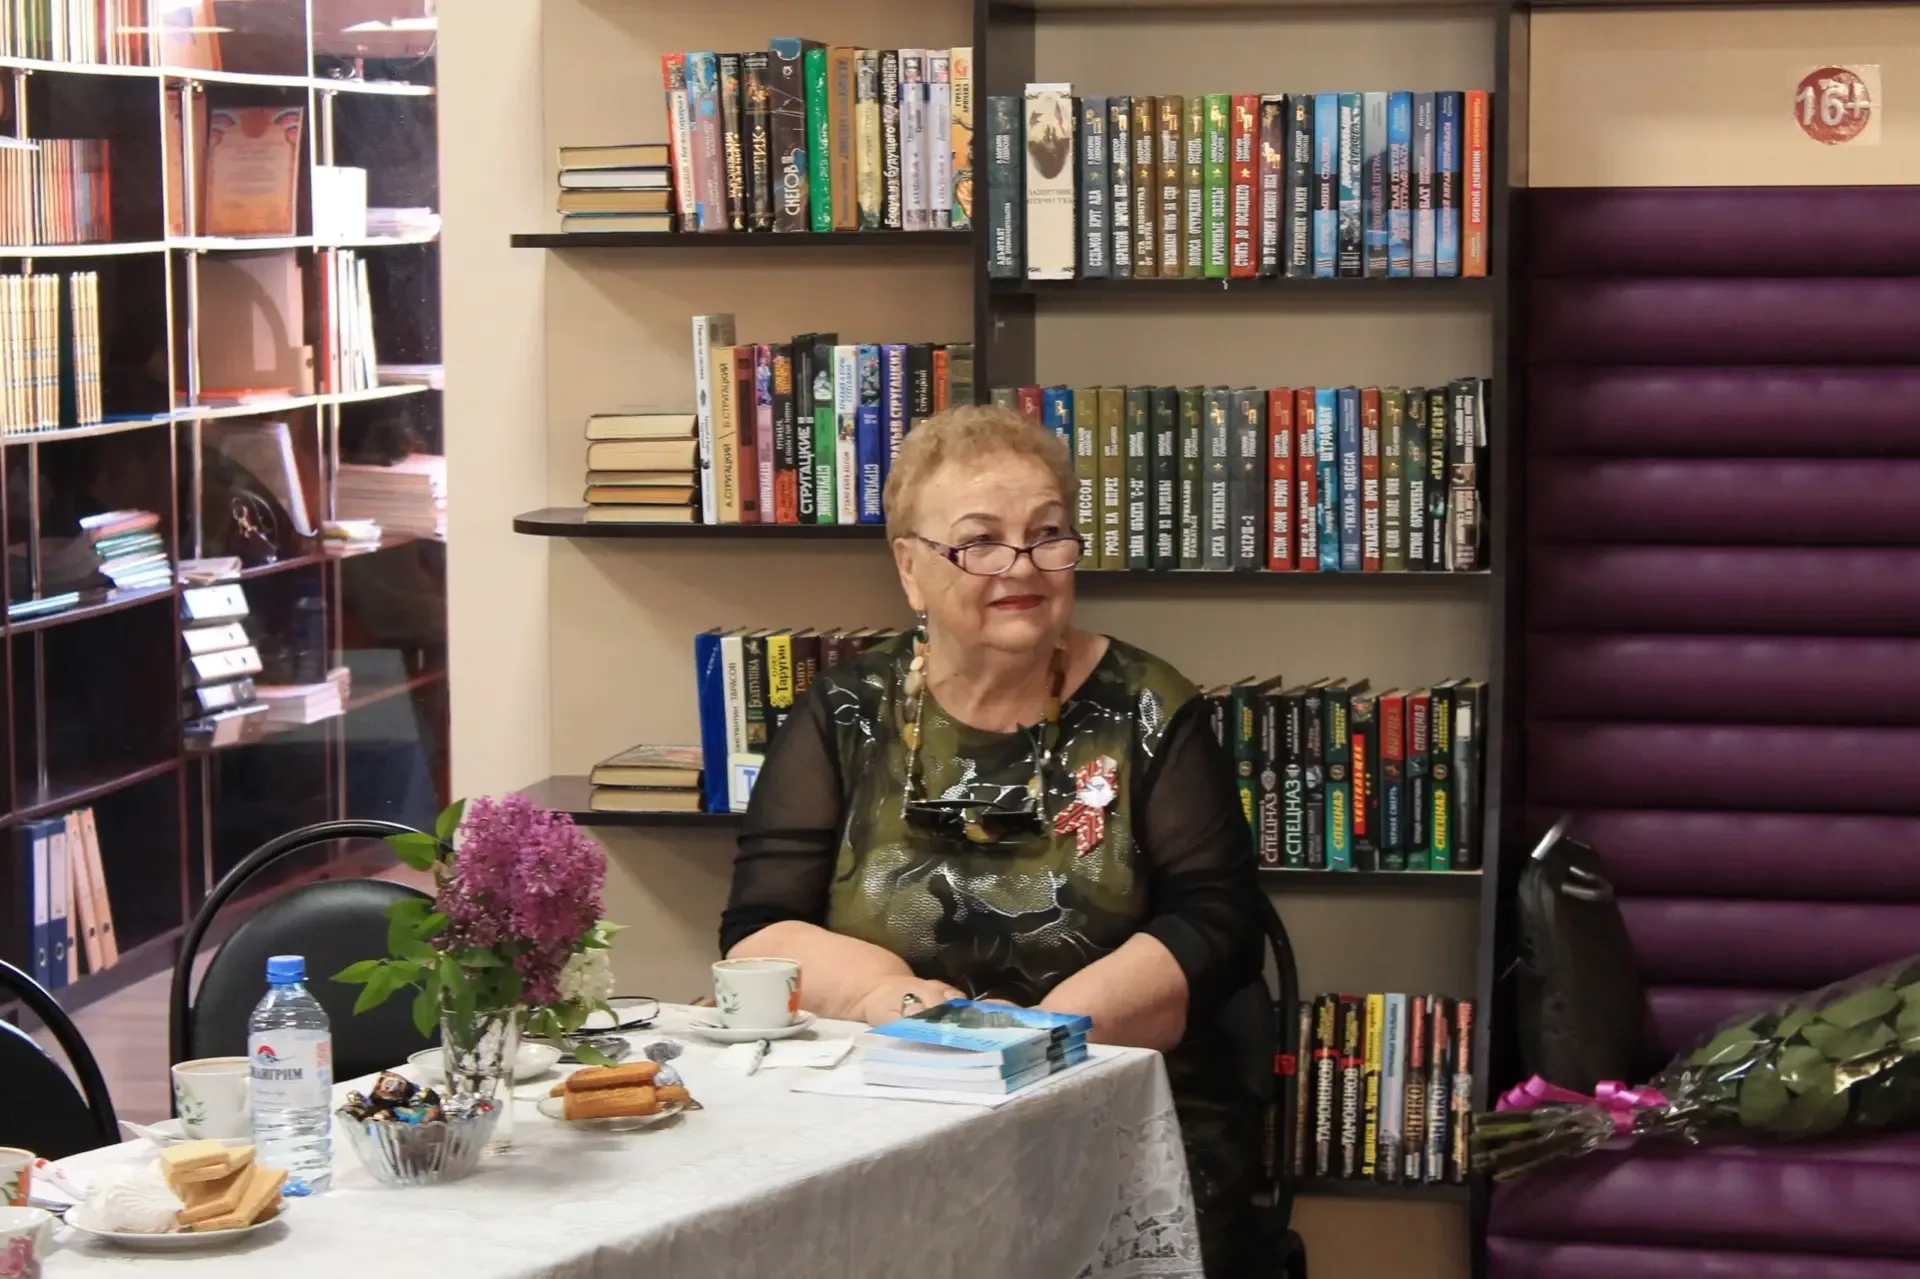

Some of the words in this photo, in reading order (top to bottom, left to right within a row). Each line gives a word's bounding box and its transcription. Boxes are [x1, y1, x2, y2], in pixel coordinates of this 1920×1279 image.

[1795, 81, 1870, 126] 16+
[882, 127, 900, 178] будущего
[1471, 151, 1481, 189] ДНЕВНИК
[784, 164, 800, 215] СНЕГОВ
[1088, 189, 1102, 205] АДА
[1114, 184, 1127, 197] НЕТ
[1163, 202, 1176, 211] НА
[1211, 187, 1226, 217] ЗВЕЗДЫ
[1235, 184, 1250, 226] ПОСЛЕДНЕГО
[1294, 186, 1308, 212] КАМНИ
[1470, 190, 1481, 223] БОЕВОЙ
[1088, 209, 1101, 227] КРУГ
[1114, 200, 1128, 226] ДОРОГИ
[1188, 189, 1202, 234] ОТЧУЖДЕНИЯ
[996, 227, 1004, 265] АДЪЮТАНТ
[1087, 233, 1104, 266] СЕДЬМОЙ
[1113, 230, 1129, 265] ОБРАТНОЙ
[1188, 239, 1202, 266] ПОЛОСА
[1211, 221, 1224, 265] КАРТОННЫЕ
[1235, 229, 1249, 239] ДО
[1264, 220, 1276, 245] СТОРОНУ
[1293, 216, 1307, 265] СТРЕЛЯЮЩИЕ
[1235, 242, 1248, 266] СТОЯТЬ
[1264, 256, 1276, 264] ПО
[719, 363, 731, 428] Б.СТРУГАЦКИЙ
[889, 350, 904, 417] СТРУГАЦКИХ
[919, 369, 928, 412] СТРУГАЦКИЙ
[890, 420, 902, 460] РАТЬЕВ
[1319, 406, 1334, 462] ШТРАФБАТ
[1431, 395, 1443, 480] КАНДАГАР
[723, 443, 733, 508] А.СТРУГАЦКИЙ
[759, 461, 772, 512] СТРУГАЦКИЕ
[799, 426, 815, 514] СТРУГАЦКИЕ
[863, 464, 880, 515] СТРУГАЦКИЕ
[1343, 451, 1358, 491] ОДЕССА
[816, 465, 832, 516] СТРУГАЦКИЕ
[1105, 477, 1119, 506] ШПРЕЕ
[1159, 479, 1172, 515] ВАРШАВЫ
[1212, 481, 1225, 530] УБИЕННЫХ
[1364, 479, 1378, 502] НОЧИ
[1409, 480, 1423, 528] ОБРЕЧЕННЫХ
[1105, 512, 1119, 524] НА
[1130, 501, 1143, 531] ОБЪЕКТА
[1159, 519, 1171, 529] ИЗ
[1362, 508, 1379, 558] ДУНАЙСКИЕ
[1105, 530, 1119, 556] ГРОЗА
[1128, 534, 1143, 557] ТАЙНА
[1156, 533, 1172, 557] МАЙОР
[1212, 535, 1225, 557] РЕКА
[1241, 515, 1254, 558] СМЕРШ-2
[1409, 532, 1423, 559] ЛЕГИОН
[729, 662, 737, 700] ТАРАСОВ
[775, 645, 789, 693] Таругин
[1414, 704, 1427, 751] СПЕЦНАЗ
[1354, 743, 1363, 823] ЧИСТИЛЬЩИК
[1388, 786, 1397, 815] СМЕРТЬ
[1263, 792, 1278, 862] СПЕЦНАЗ
[1285, 779, 1303, 854] СПЕЦНАЗ
[1333, 790, 1345, 849] СПЕЦНАЗ
[1389, 816, 1398, 845] ЧЕРНАЯ
[1433, 789, 1447, 849] СПЕЦНАЗ
[1316, 1059, 1334, 1143] ТАМОНИКОВ
[1341, 1068, 1358, 1146] ТАМОНИКОВ
